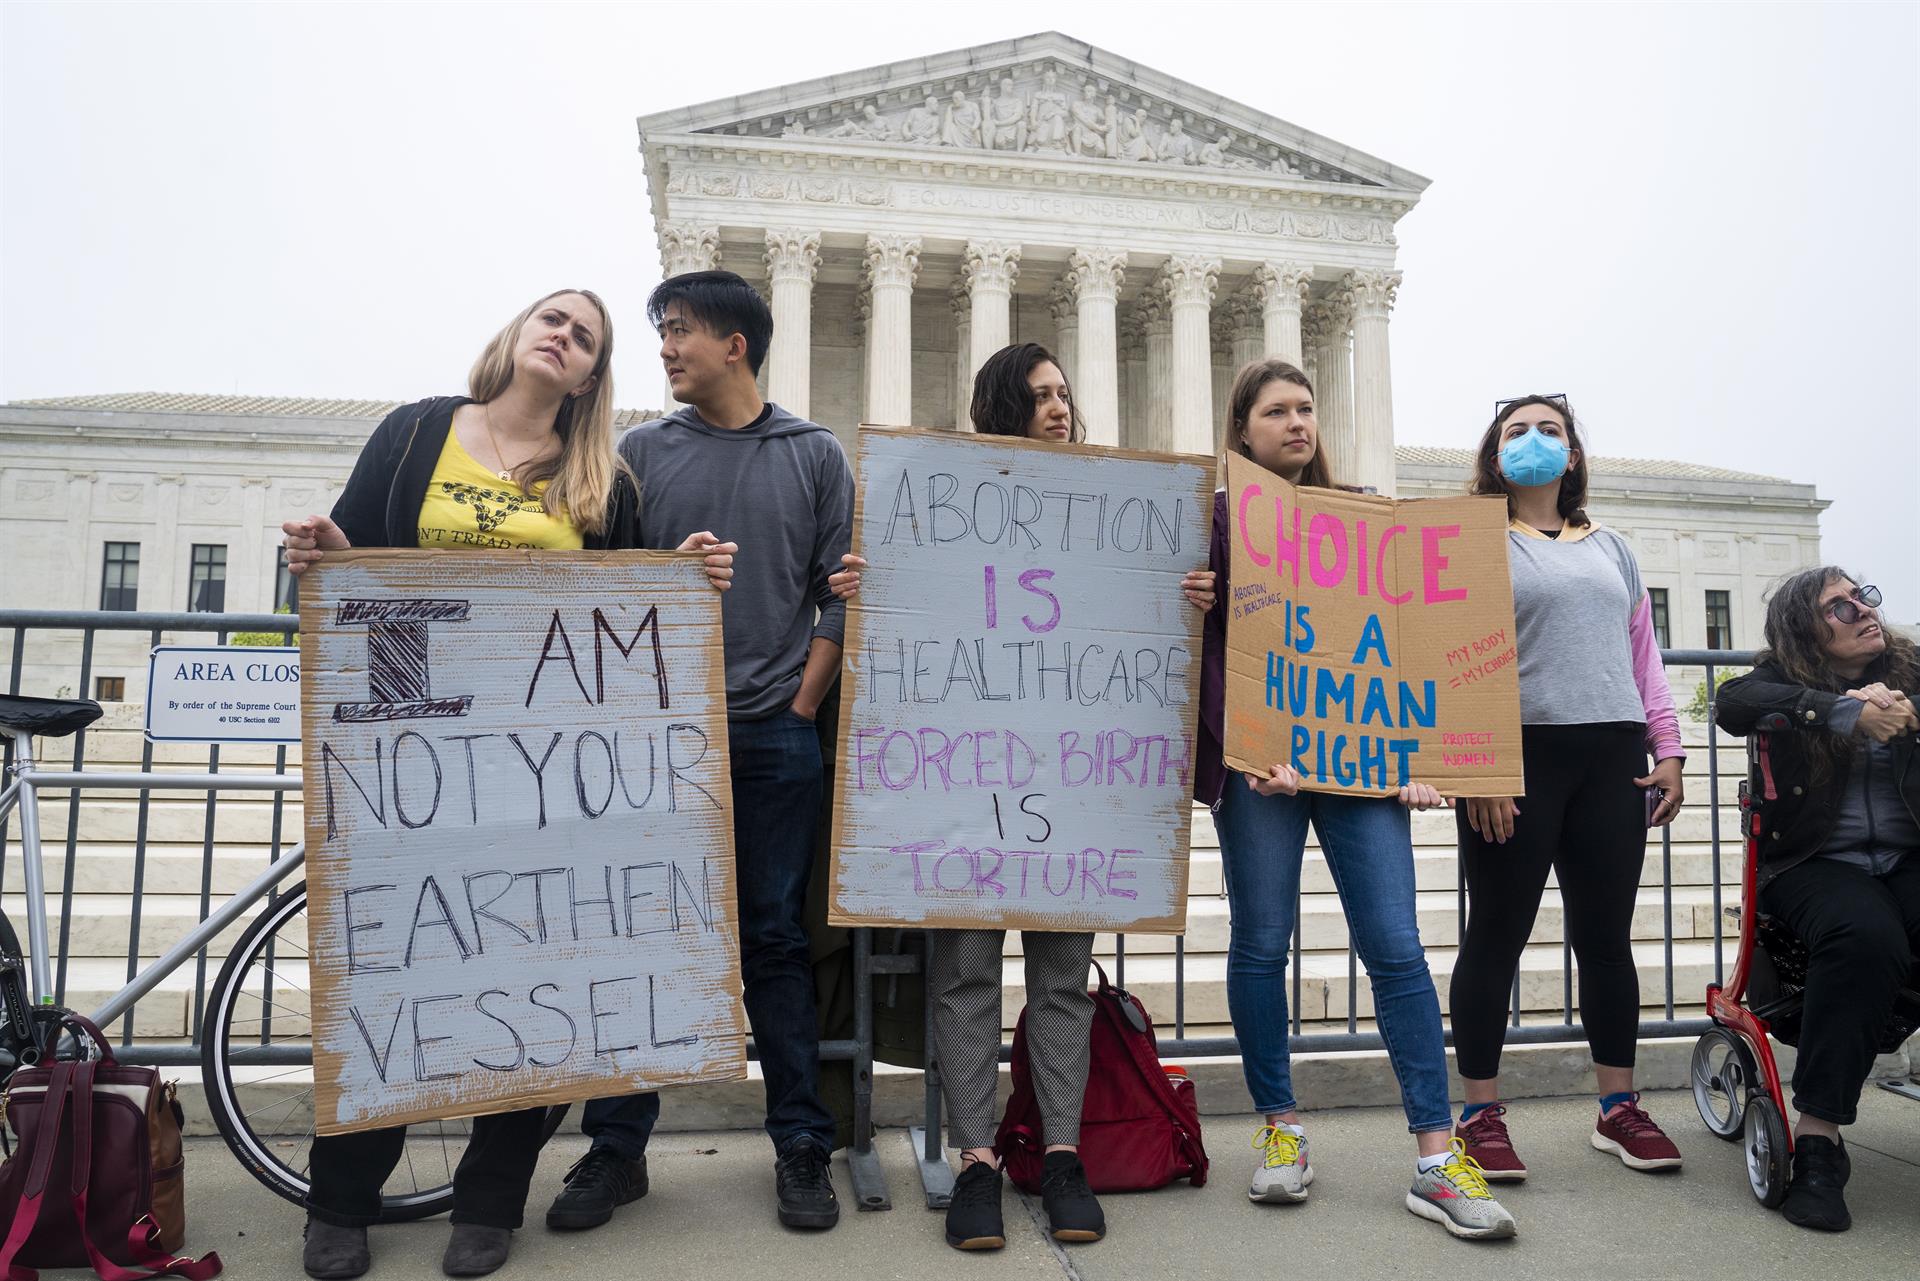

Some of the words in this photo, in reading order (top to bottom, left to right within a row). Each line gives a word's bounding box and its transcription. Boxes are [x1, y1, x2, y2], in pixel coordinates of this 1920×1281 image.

[910, 189, 976, 208] EQUAL
[983, 196, 1061, 215] JUSTICE
[1072, 200, 1135, 221] UNDER
[1145, 207, 1184, 223] LAW
[451, 530, 511, 549] TREAD
[882, 469, 1181, 554] ABORTION
[1239, 483, 1467, 606] CHOICE
[984, 565, 1061, 633] IS
[1233, 606, 1242, 620] IS
[1234, 582, 1266, 600] ABORTION
[332, 599, 475, 722] I
[525, 603, 669, 709] AM
[1285, 600, 1315, 654] IS
[1352, 614, 1392, 668] A
[1447, 646, 1470, 667] MY
[1472, 629, 1506, 656] BODY
[174, 662, 236, 681] AREA
[868, 637, 1187, 708] HEALTHCARE
[1266, 650, 1436, 729] HUMAN
[169, 700, 179, 710] By
[183, 701, 204, 710] order
[208, 701, 217, 710] of
[220, 701, 233, 710] the
[236, 701, 270, 712] Supreme
[274, 702, 297, 711] Court
[244, 716, 265, 724] Section
[854, 727, 1036, 793] FORCED
[1060, 729, 1192, 789] BIRTH
[1291, 725, 1419, 790] RIGHT
[1442, 733, 1494, 745] PROTECT
[1442, 752, 1495, 767] WOMEN
[322, 730, 498, 842] NOT
[508, 723, 724, 831] YOUR
[992, 793, 1052, 843] IS
[889, 840, 1145, 900] TORTURE
[344, 857, 715, 977] EARTHEN
[349, 975, 700, 1085] VESSEL
